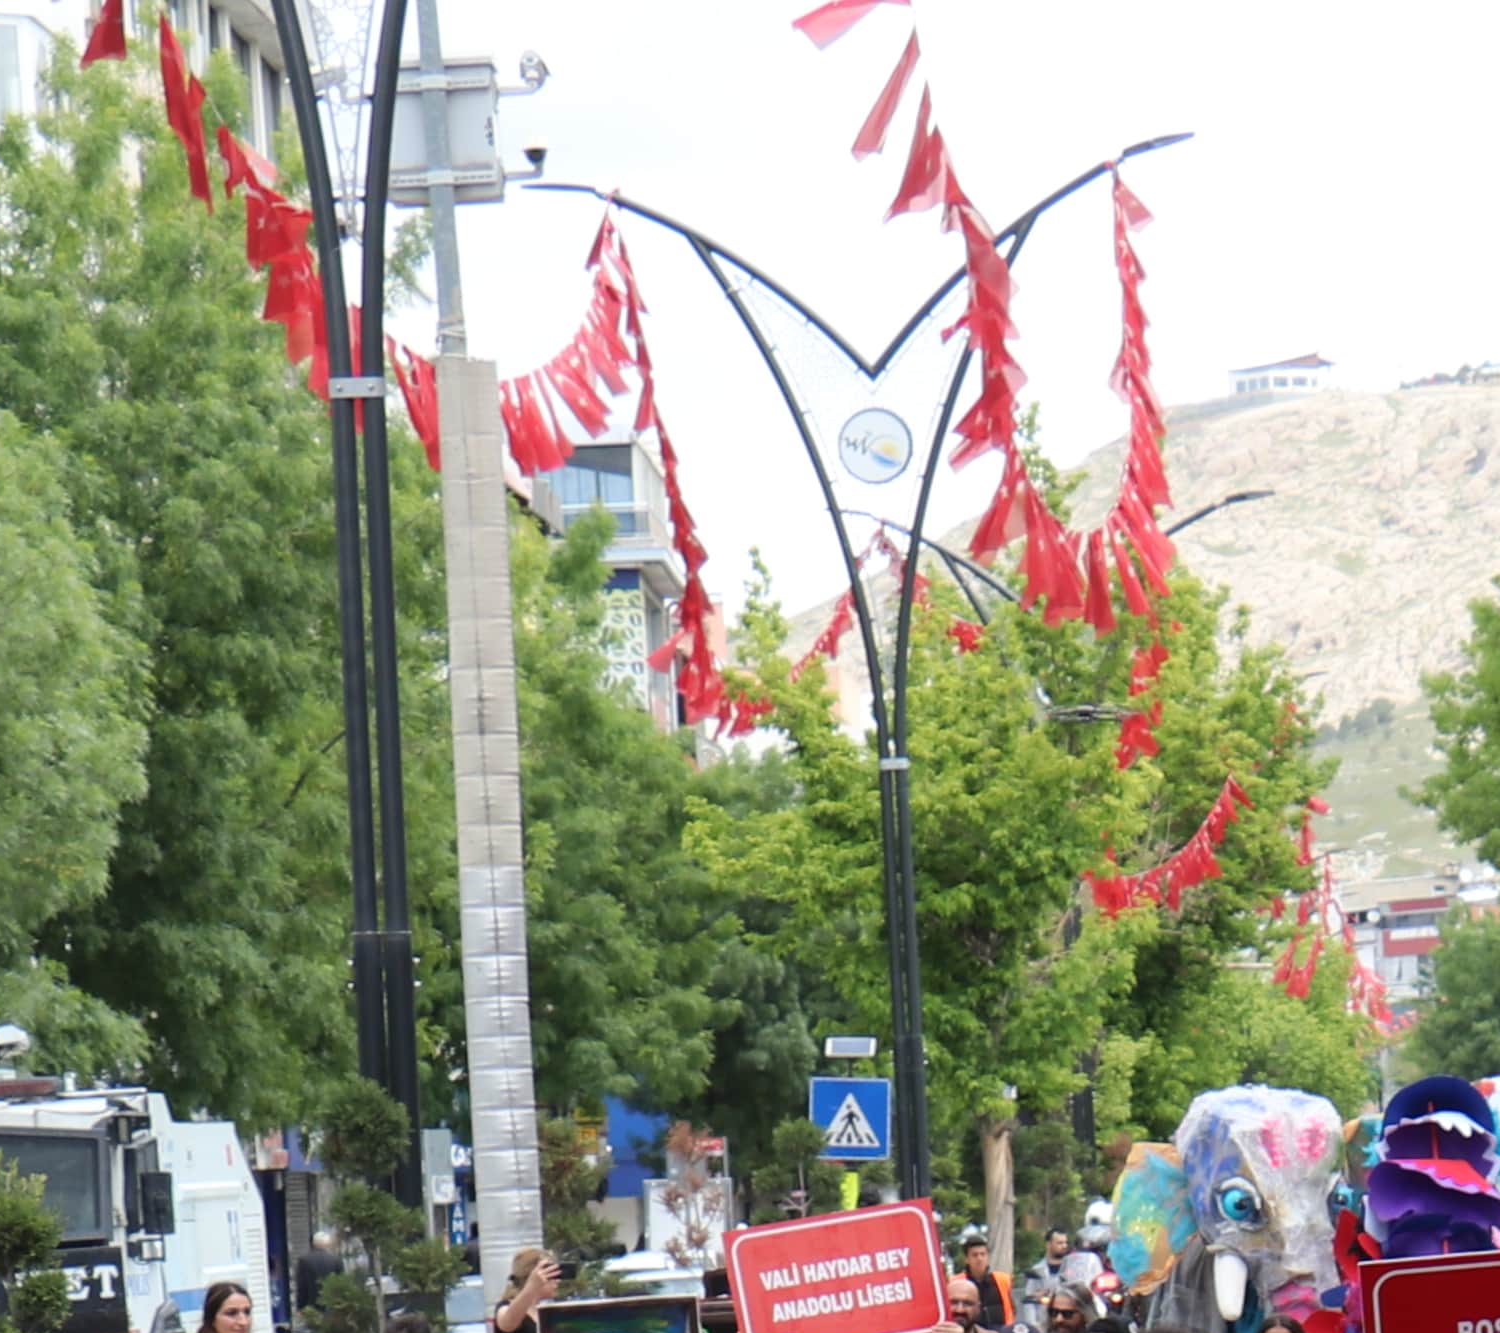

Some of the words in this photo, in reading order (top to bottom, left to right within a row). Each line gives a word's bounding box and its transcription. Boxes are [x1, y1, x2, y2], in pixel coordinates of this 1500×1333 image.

[760, 1263, 800, 1291] VALİ
[802, 1254, 872, 1283] HAYDAR
[875, 1248, 910, 1270] BEY
[772, 1291, 853, 1323] ANADOLU
[858, 1277, 914, 1308] LİSESİ
